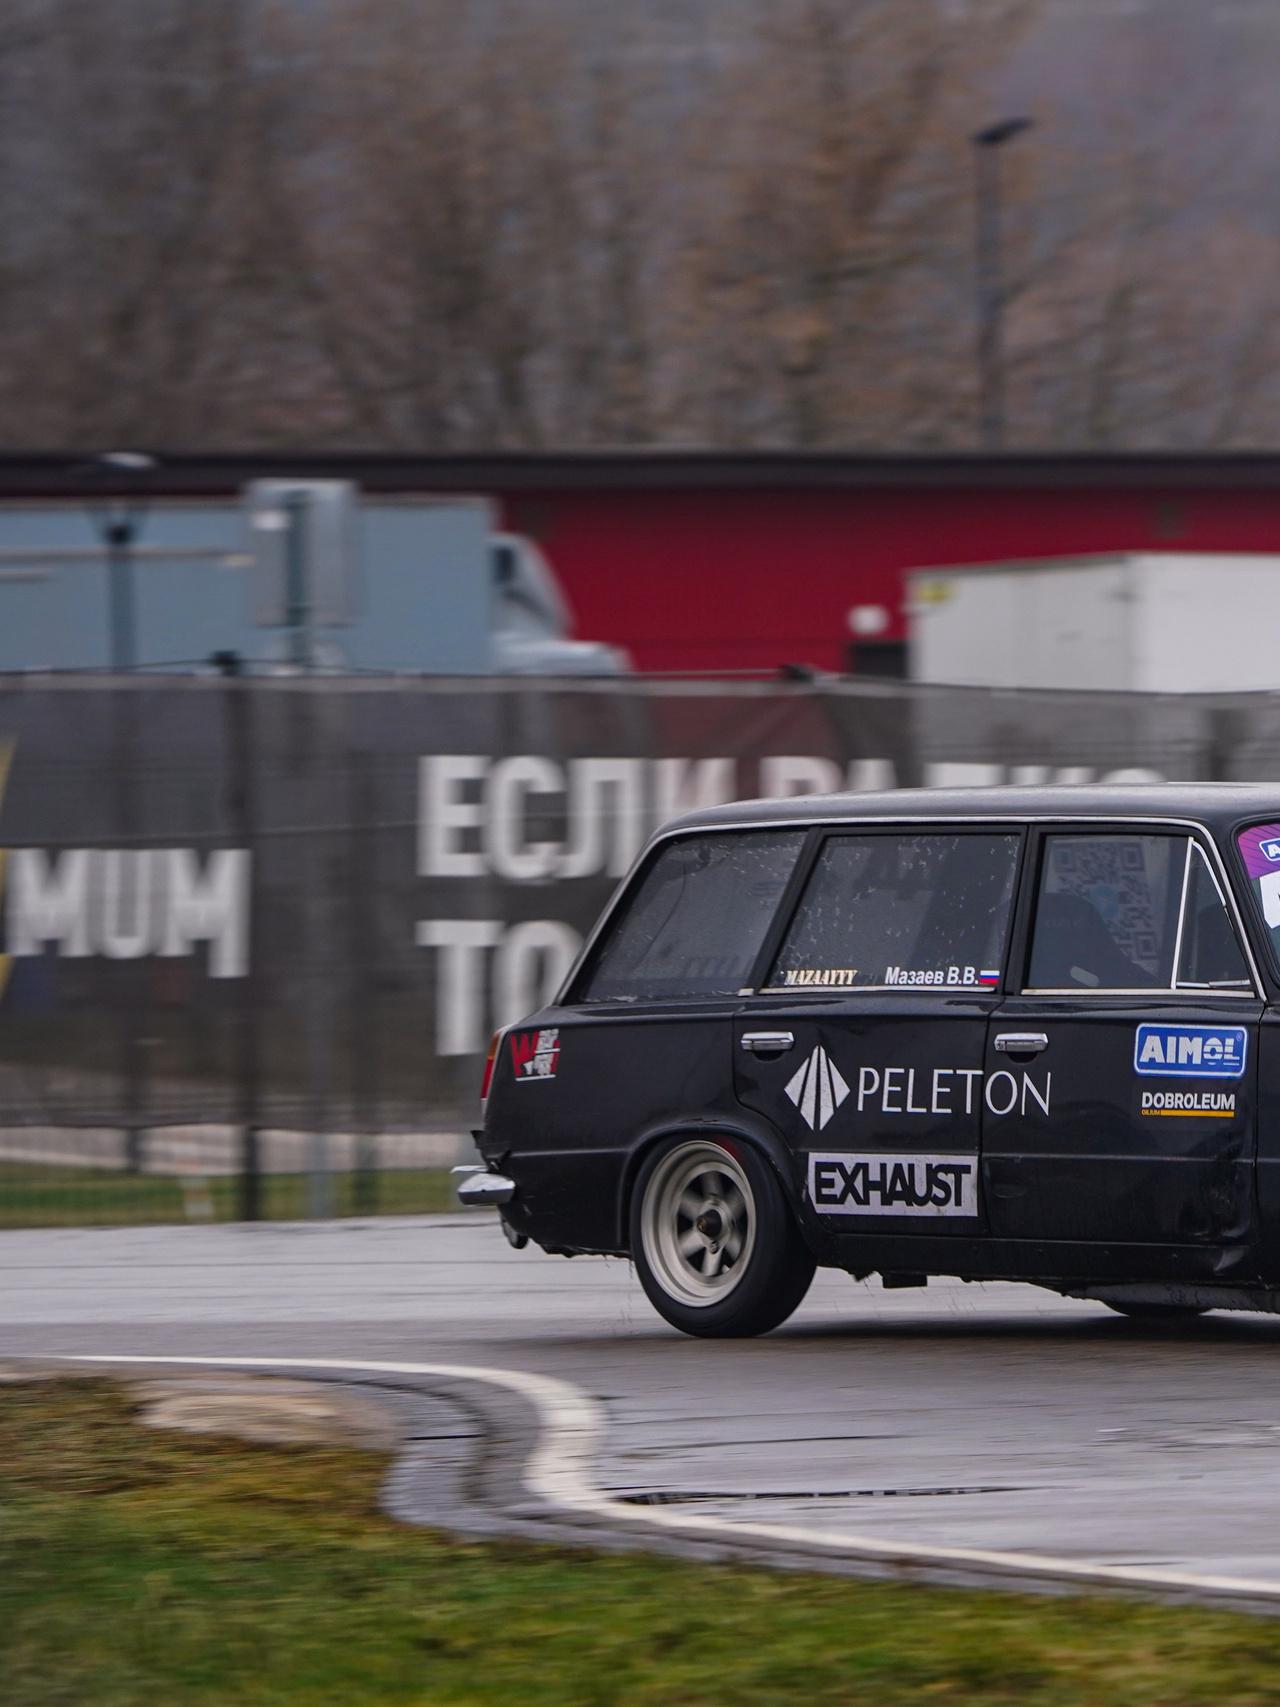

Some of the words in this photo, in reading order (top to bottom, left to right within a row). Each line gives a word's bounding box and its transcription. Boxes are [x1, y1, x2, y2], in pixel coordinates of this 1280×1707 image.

[885, 966, 944, 984] Мазаев
[947, 966, 979, 984] В.В.
[1140, 1035, 1240, 1065] AIMOL
[858, 1067, 1051, 1116] PELETON
[1142, 1092, 1235, 1109] DOBROLEUM
[814, 1161, 971, 1206] EXHAUST
